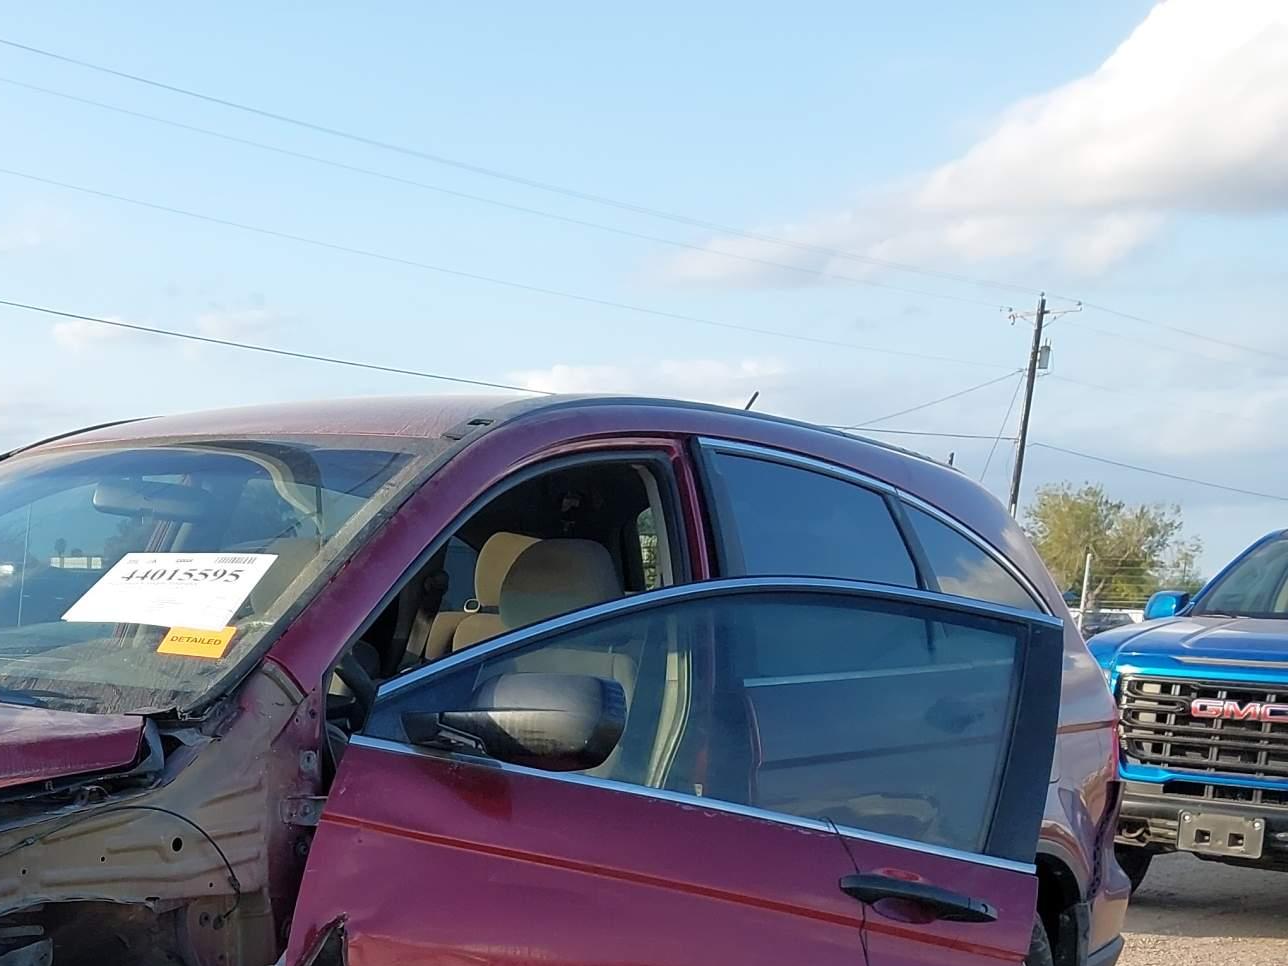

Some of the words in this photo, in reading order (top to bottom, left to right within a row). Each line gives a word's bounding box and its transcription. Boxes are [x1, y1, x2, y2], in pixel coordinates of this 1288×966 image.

[121, 569, 244, 583] 44015595
[170, 635, 223, 646] DETAILED
[1191, 698, 1288, 723] GMC
